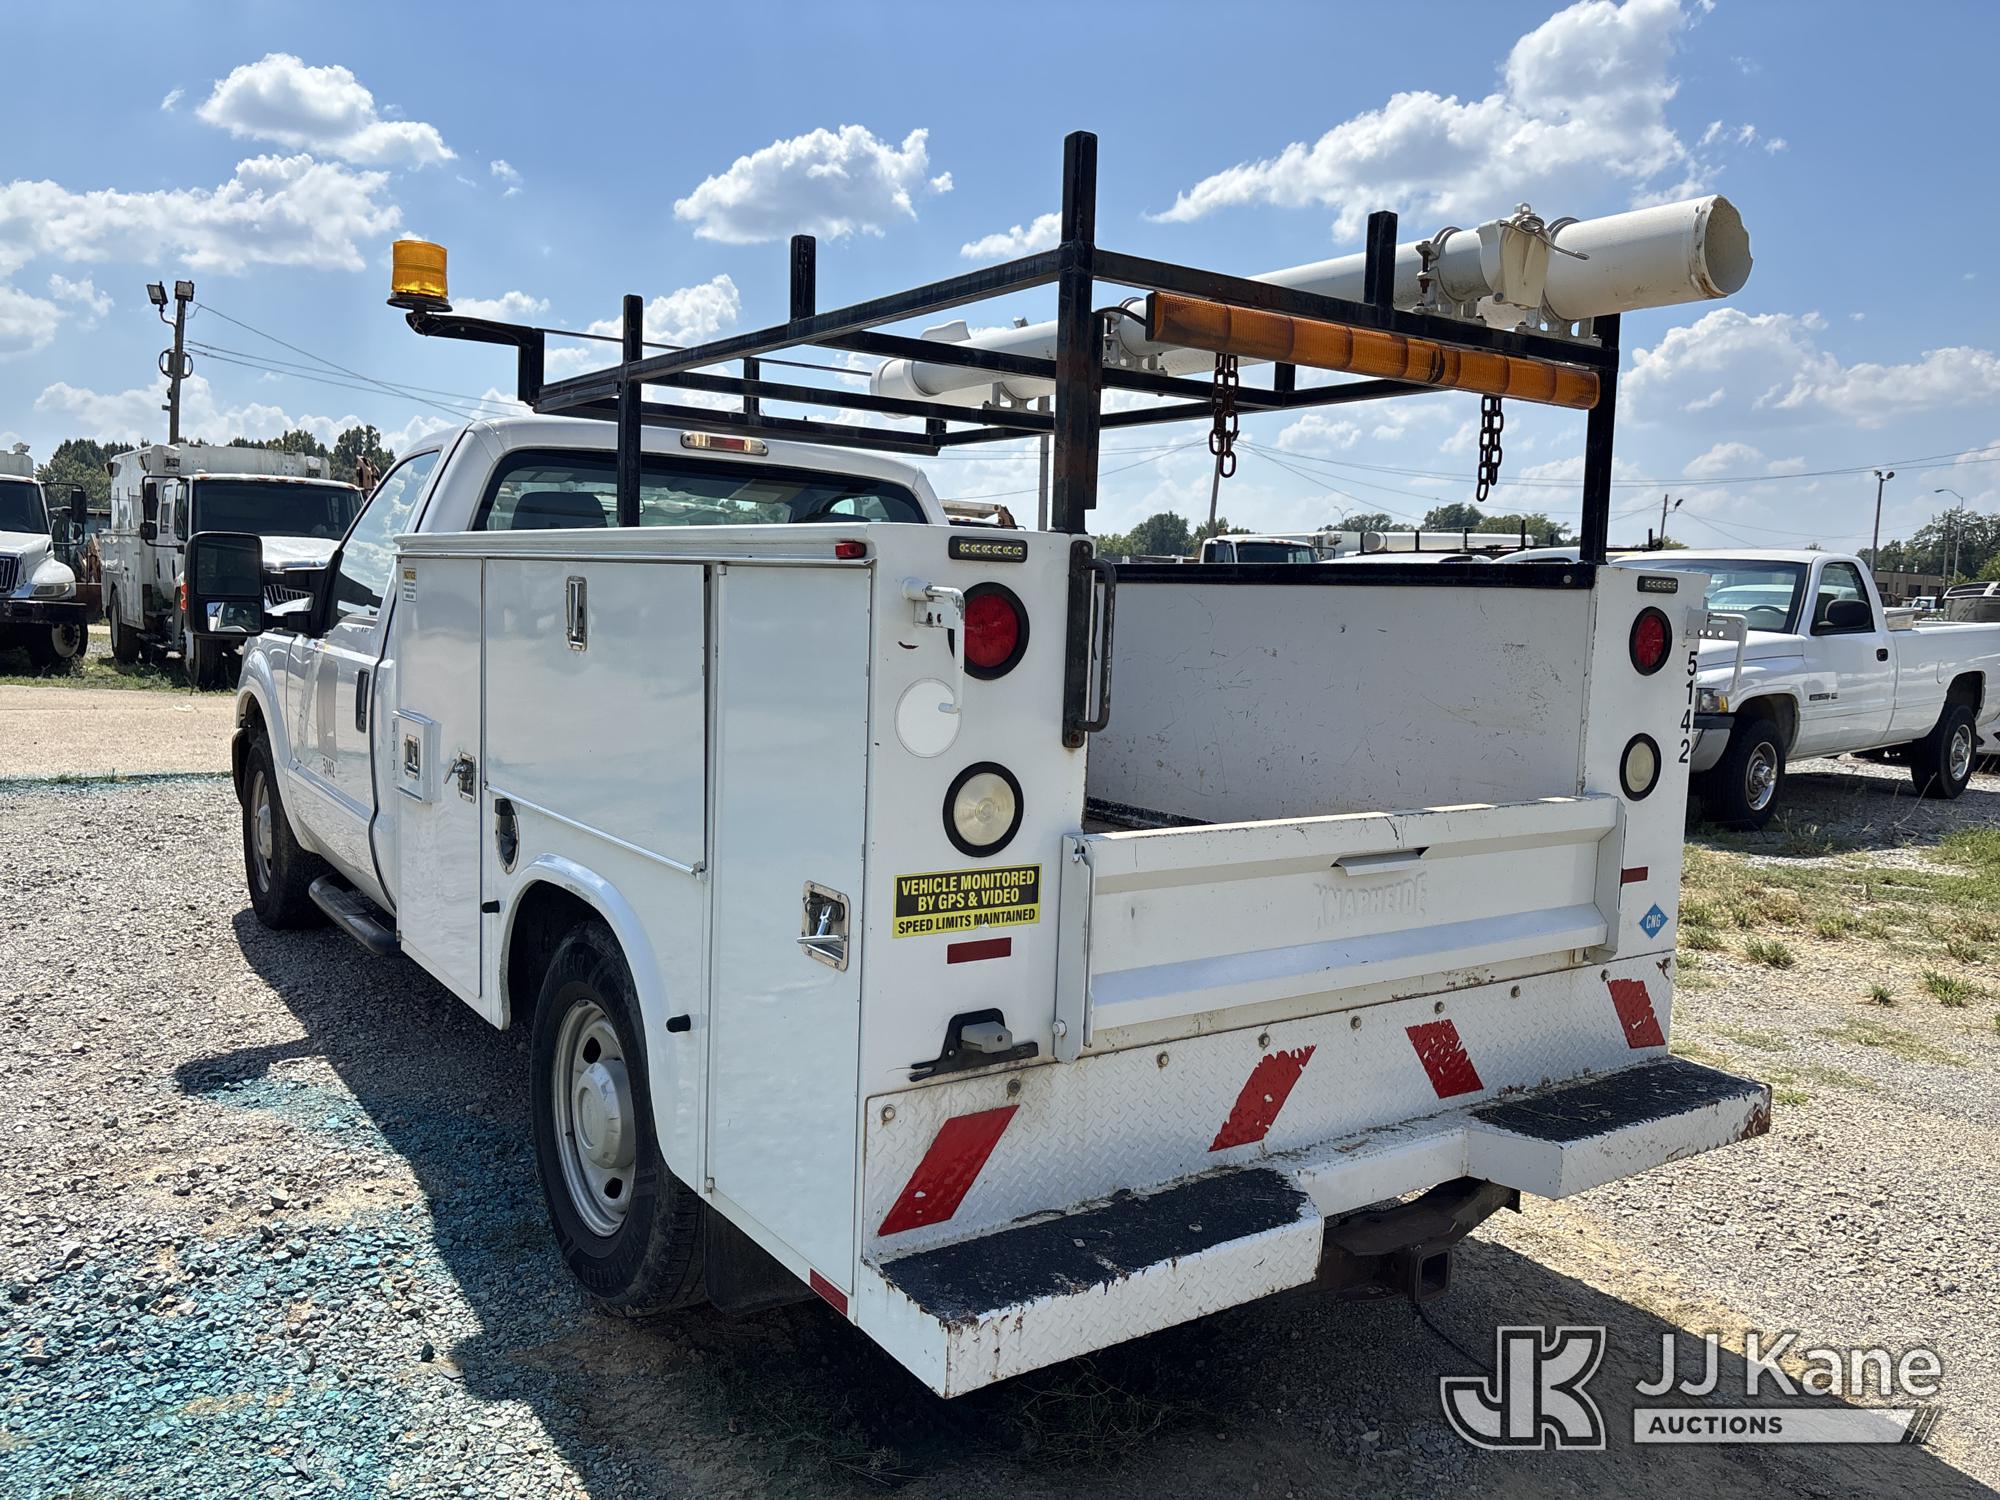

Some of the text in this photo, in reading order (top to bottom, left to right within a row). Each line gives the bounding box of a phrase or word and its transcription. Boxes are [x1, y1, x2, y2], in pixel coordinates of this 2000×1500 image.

[1679, 651, 1698, 763] 5142
[323, 757, 336, 778] 5142
[901, 870, 1035, 896] VEHICLE MONITORED
[917, 888, 1020, 912] BY GPS & VIDEO
[898, 908, 1036, 934] SPEED LIMITS MAINTAINED
[1646, 913, 1661, 929] CNG
